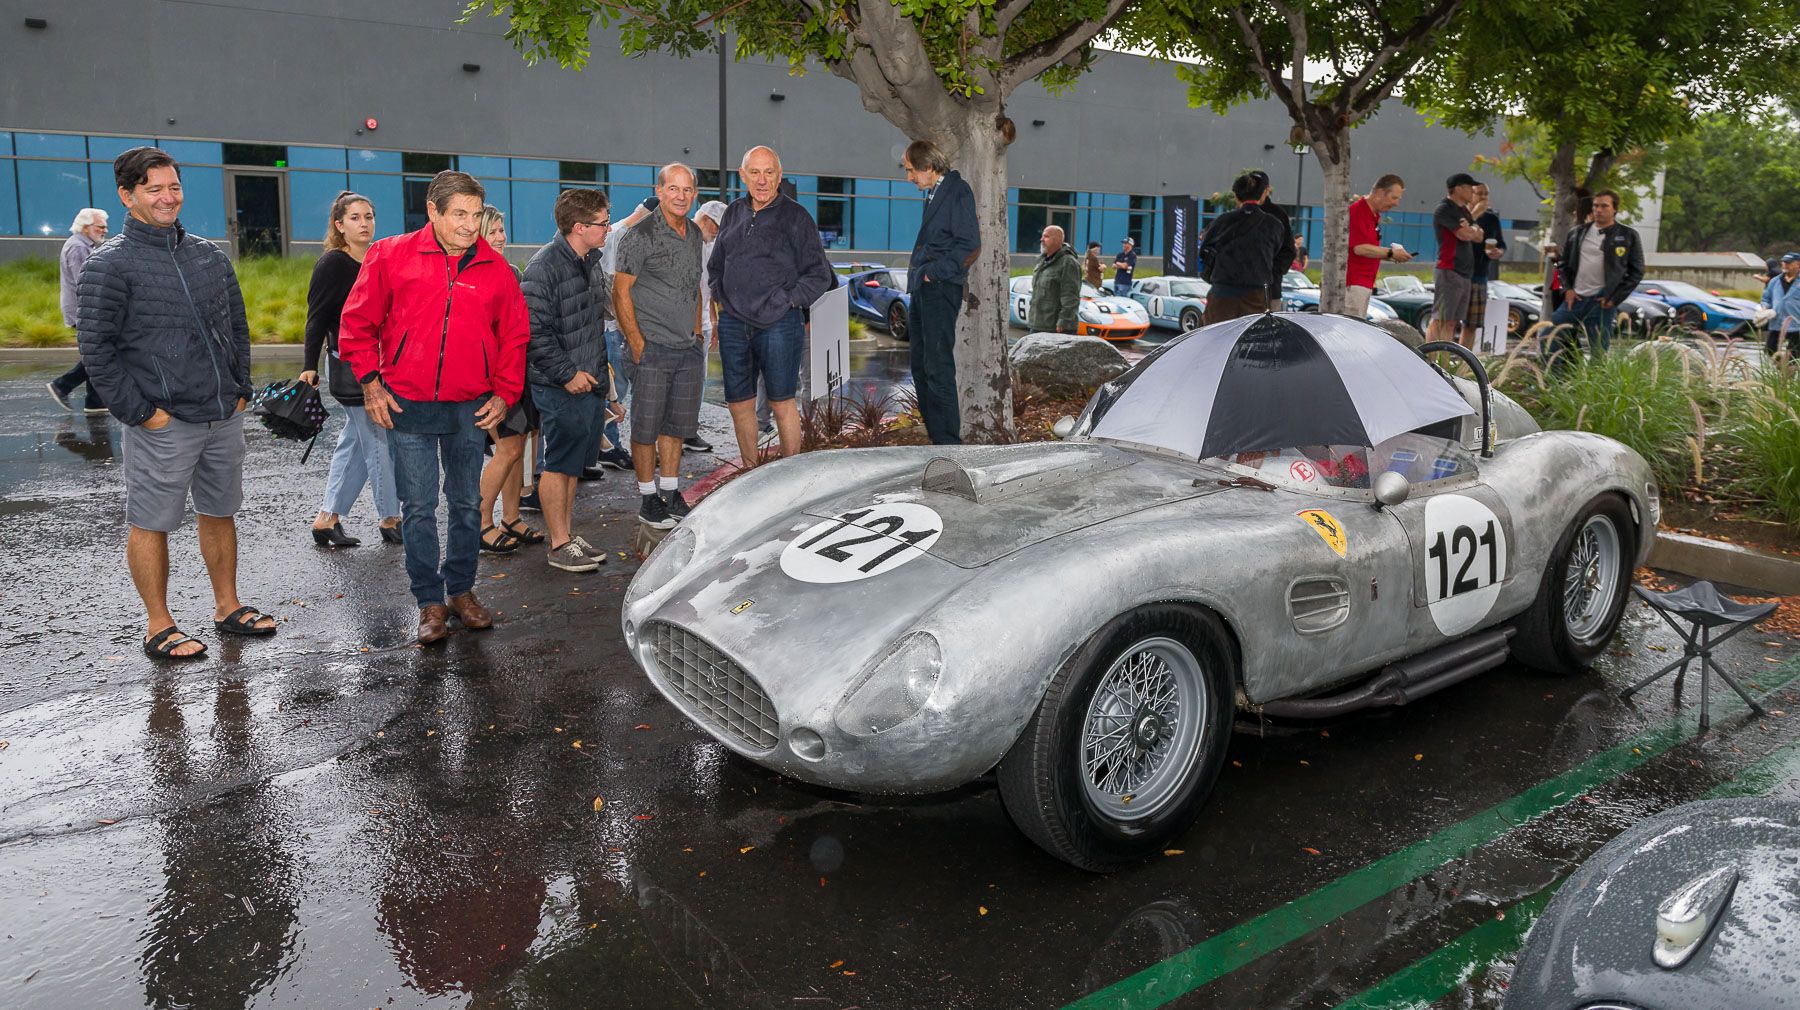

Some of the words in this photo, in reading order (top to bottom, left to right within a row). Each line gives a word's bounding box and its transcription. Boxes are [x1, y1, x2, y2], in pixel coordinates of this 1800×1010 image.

[1171, 207, 1186, 273] Hillbank
[1018, 298, 1026, 320] 6
[1153, 298, 1159, 316] 1
[1292, 463, 1313, 481] E
[798, 508, 940, 573] 121
[1428, 520, 1497, 600] 121
